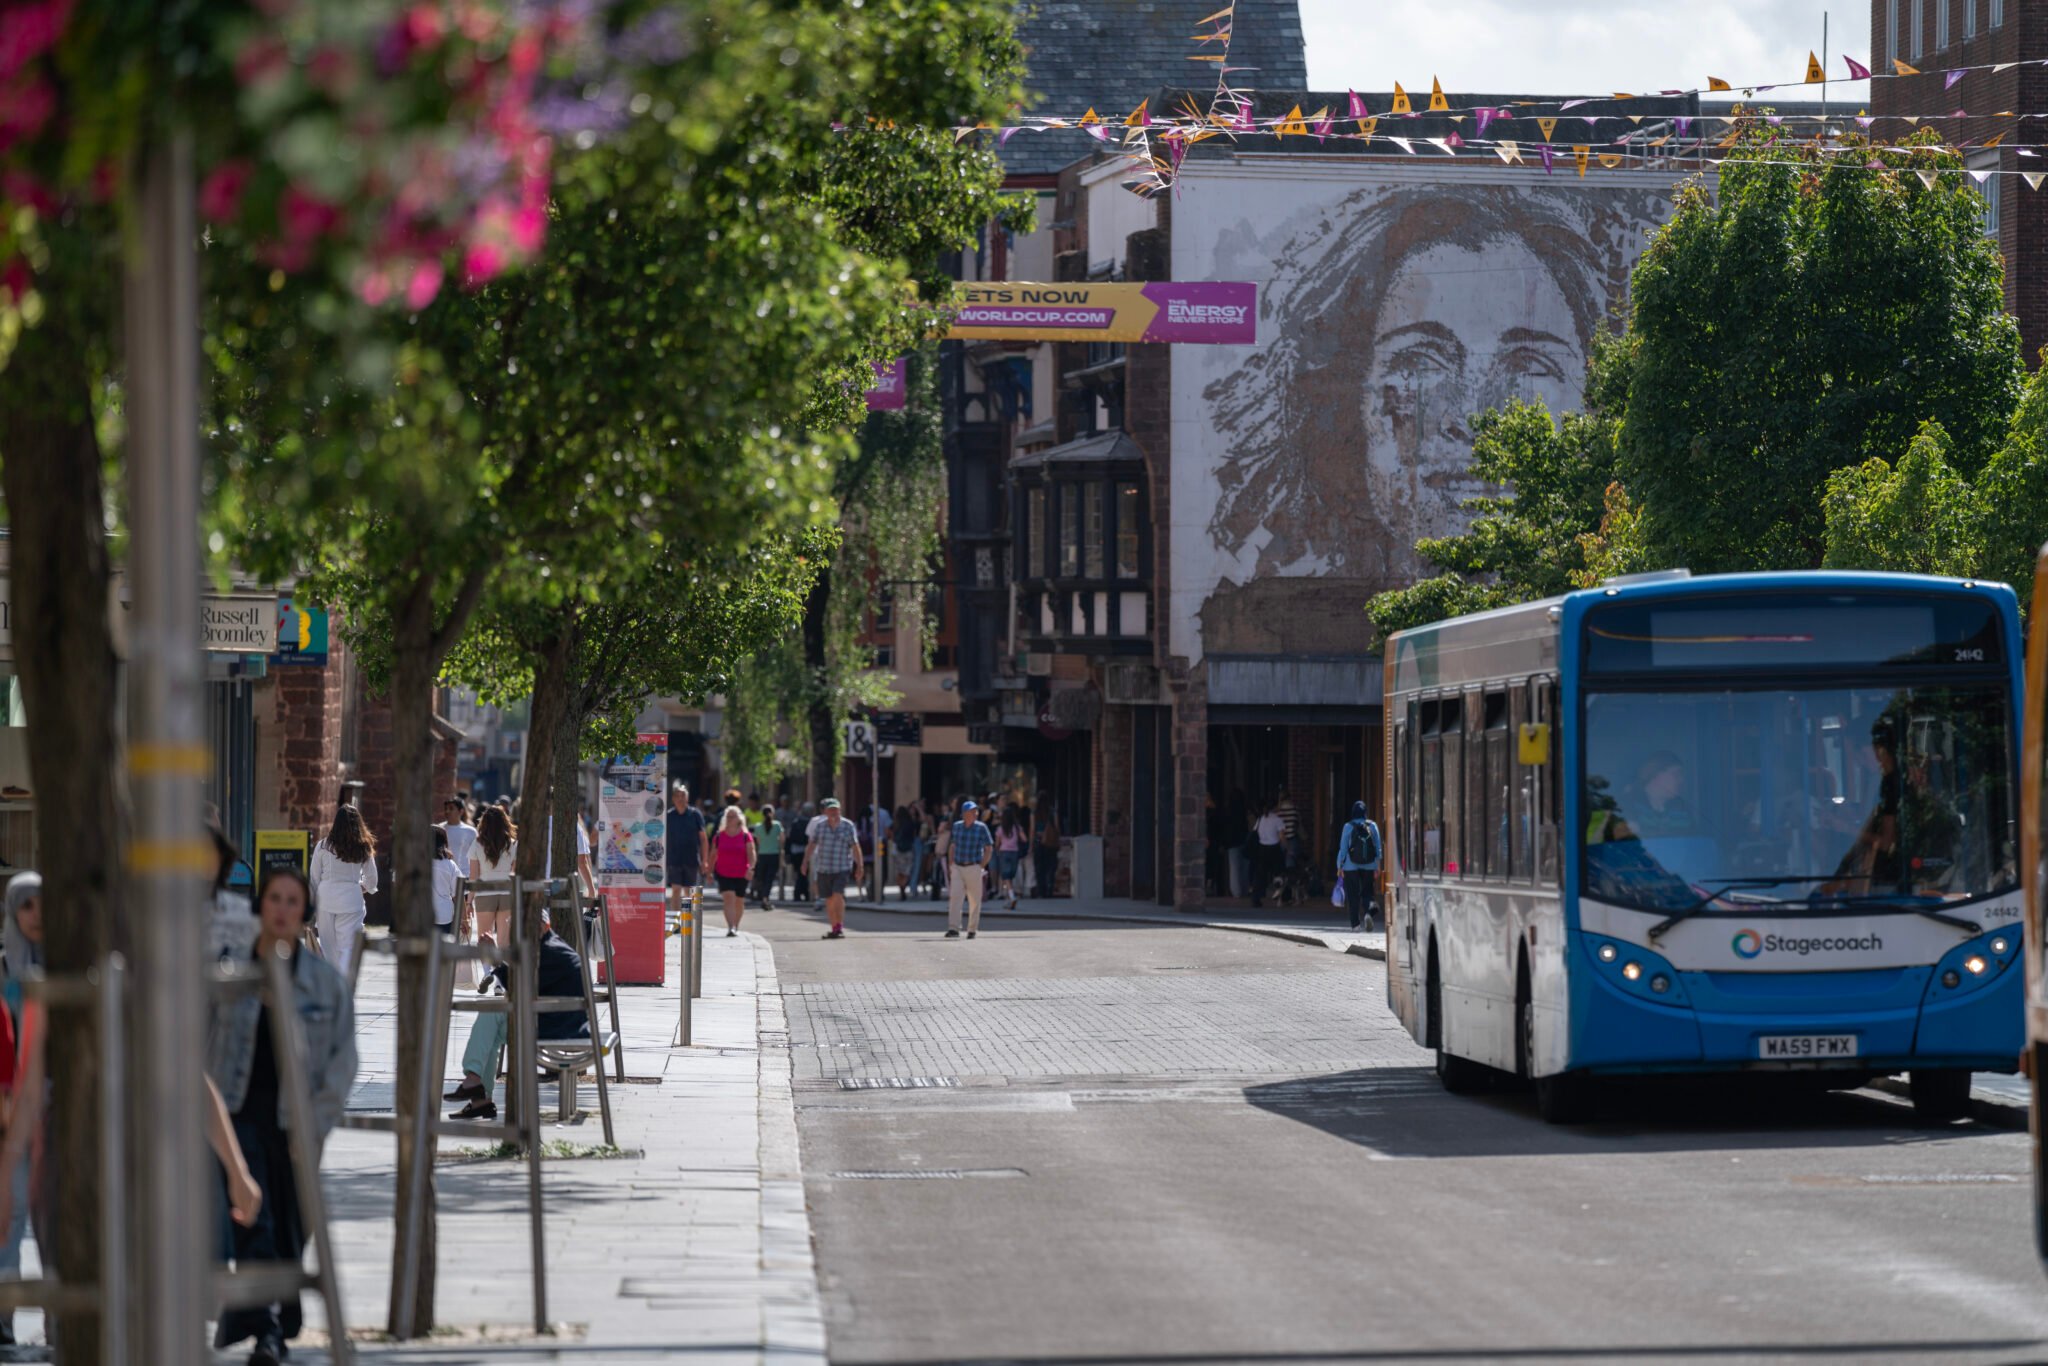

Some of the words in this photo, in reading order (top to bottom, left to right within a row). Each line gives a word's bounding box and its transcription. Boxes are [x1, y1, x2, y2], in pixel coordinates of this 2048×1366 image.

[966, 290, 1013, 303] ETS
[1022, 290, 1089, 304] NOW
[959, 310, 1106, 323] WORLDCUP.COM
[1168, 305, 1248, 317] ENERGY
[1207, 317, 1245, 325] STOPS
[200, 606, 259, 625] Russell
[199, 624, 269, 647] Bromley
[1954, 648, 1984, 661] 24142
[1984, 907, 2020, 918] 24142
[1764, 932, 1883, 956] Stagecoach
[1766, 1038, 1812, 1055] WA59
[1816, 1037, 1851, 1054] FWX
